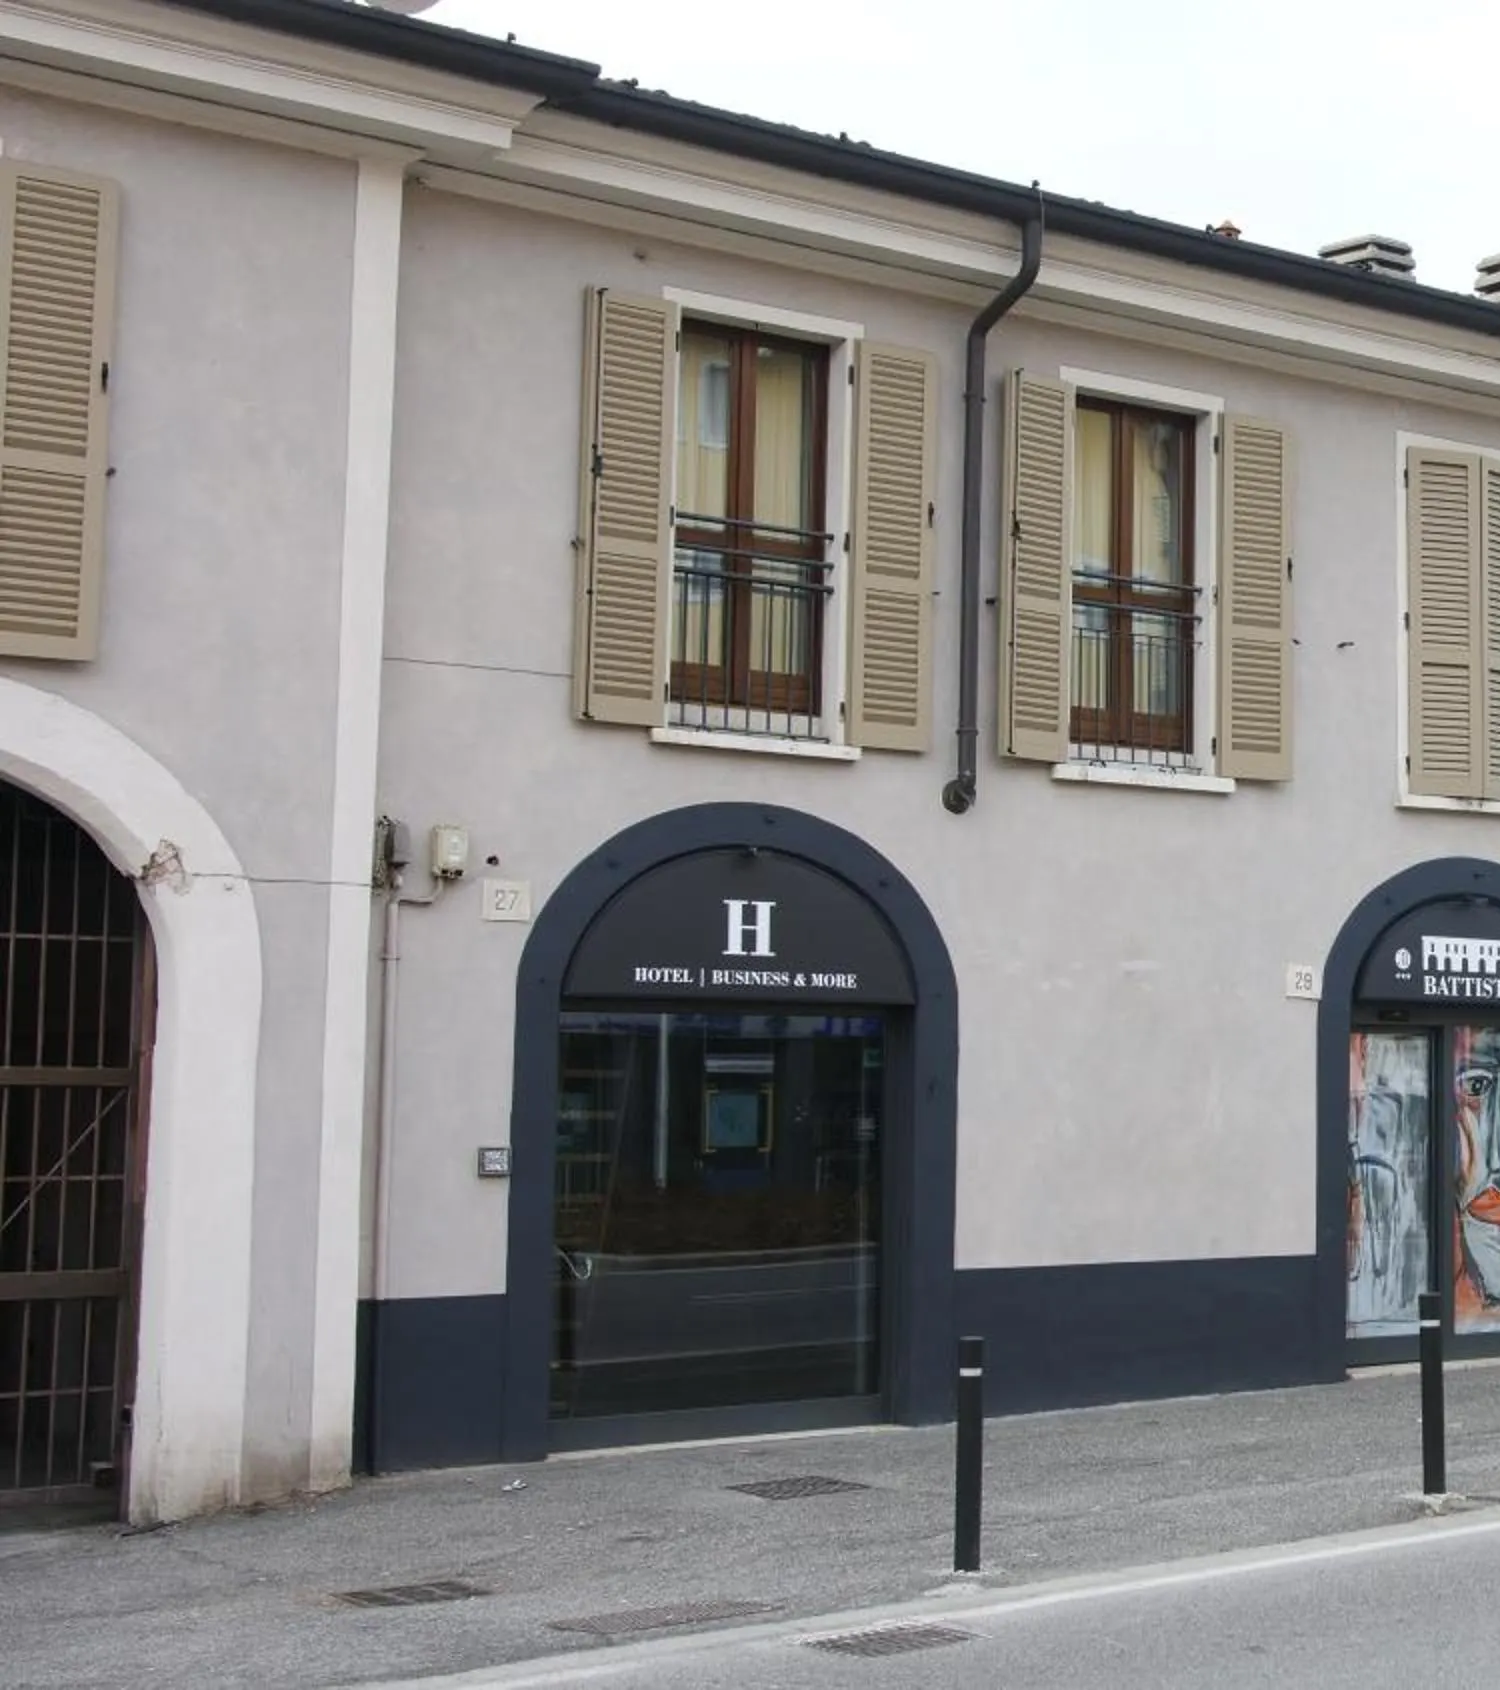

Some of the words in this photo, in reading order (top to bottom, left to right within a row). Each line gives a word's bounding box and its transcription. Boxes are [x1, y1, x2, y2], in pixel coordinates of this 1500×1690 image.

[495, 889, 519, 911] 27
[722, 899, 776, 957] H
[634, 967, 694, 984] HOTEL
[712, 969, 790, 986] BUSINESS
[793, 974, 807, 987] &
[811, 973, 858, 989] MORE
